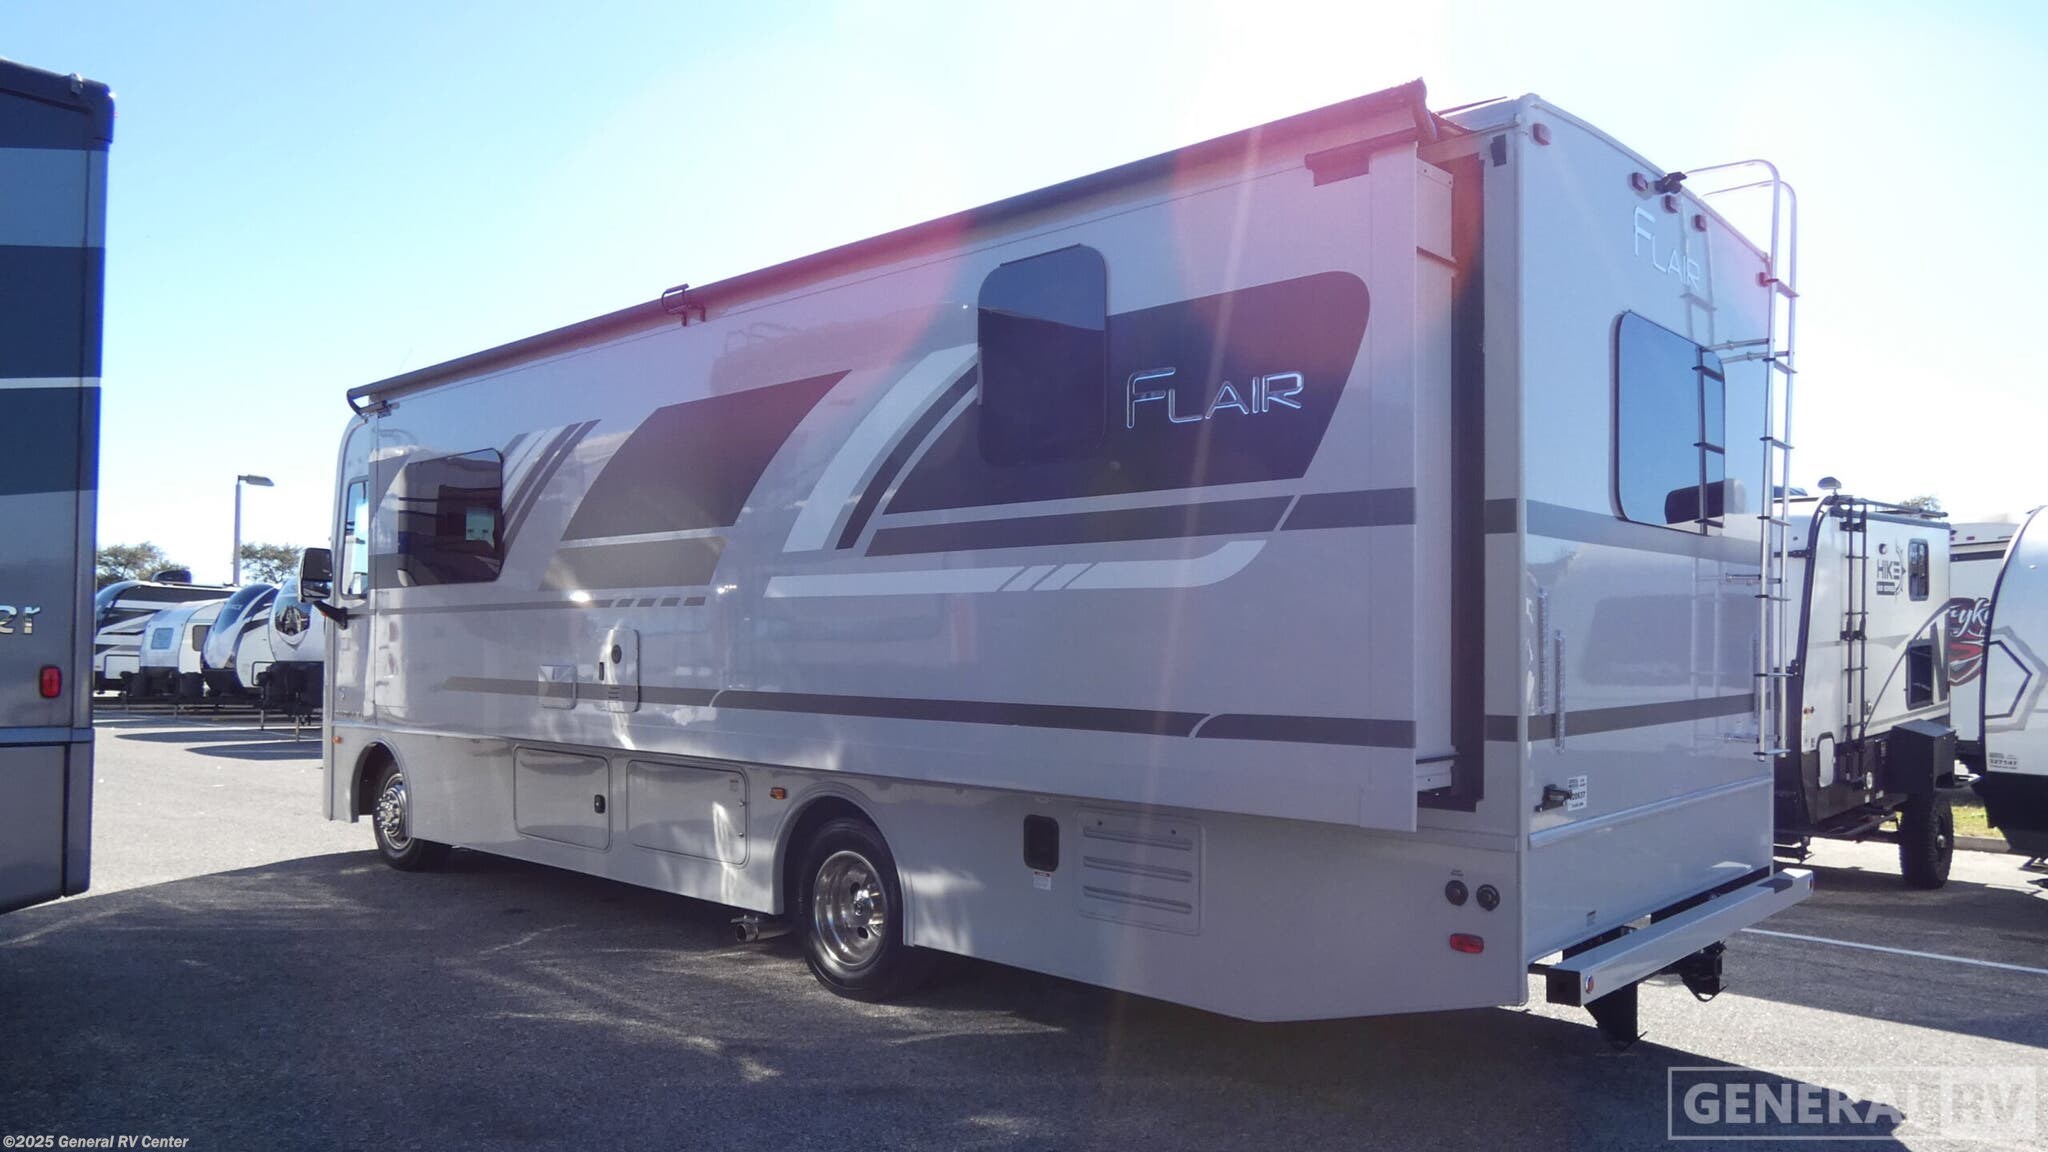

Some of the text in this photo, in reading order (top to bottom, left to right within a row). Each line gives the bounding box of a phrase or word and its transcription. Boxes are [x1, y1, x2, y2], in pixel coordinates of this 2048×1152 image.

[1634, 206, 1700, 290] FLAIR
[1126, 366, 1304, 428] FLAIR
[1877, 559, 1900, 580] HIKE
